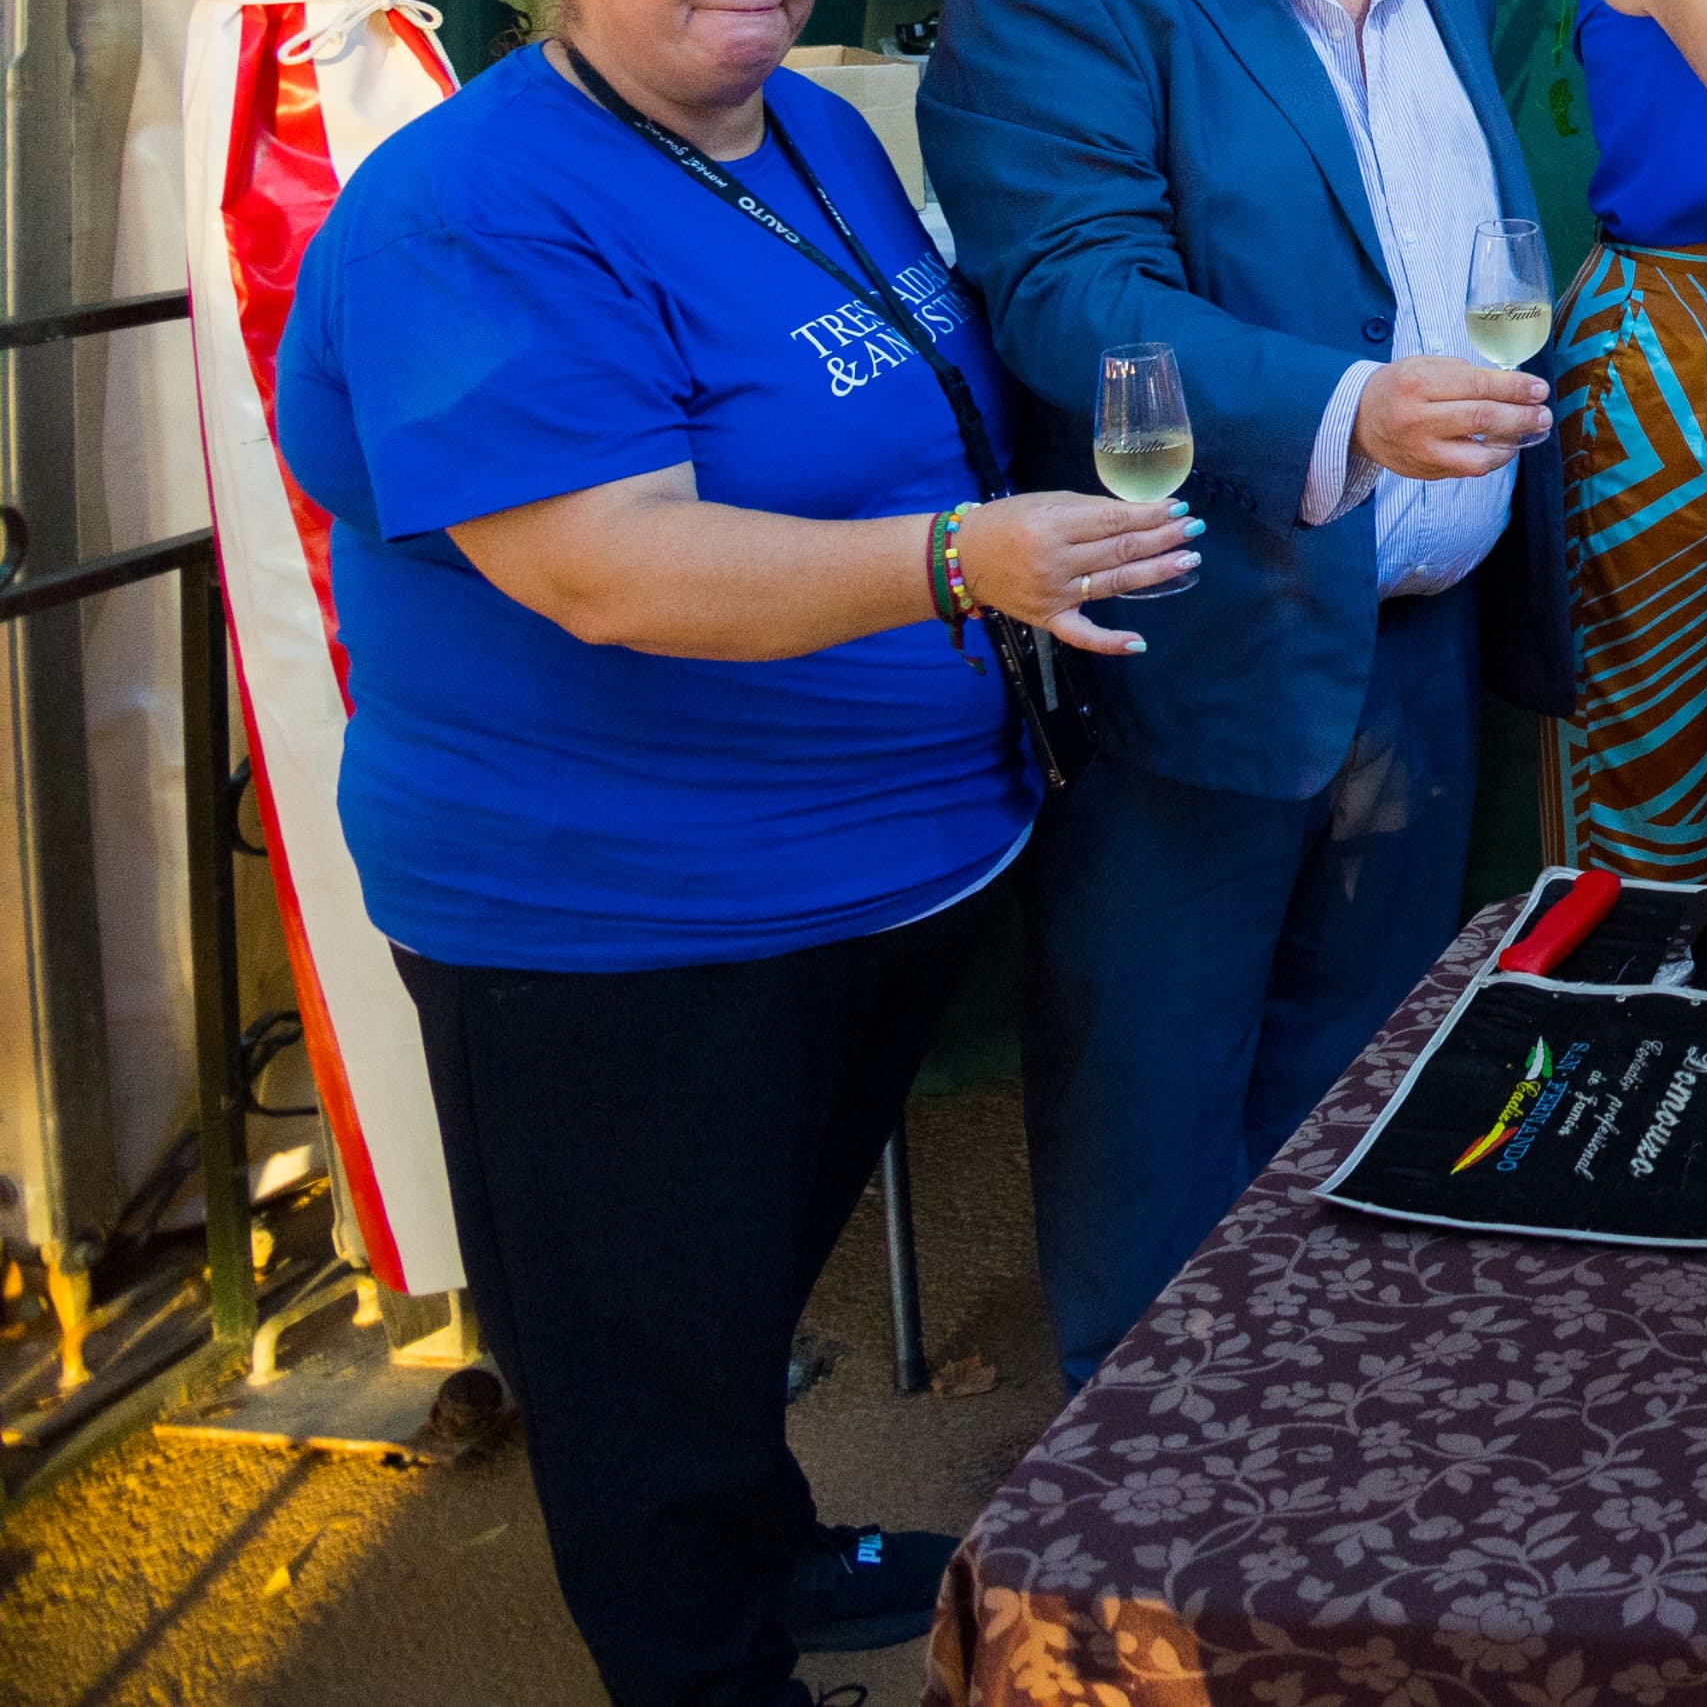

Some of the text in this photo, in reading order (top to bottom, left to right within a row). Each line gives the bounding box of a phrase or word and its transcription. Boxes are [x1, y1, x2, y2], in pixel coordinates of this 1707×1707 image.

[790, 299, 886, 359] TRES
[1478, 303, 1542, 322] La Guita
[826, 356, 869, 398] &
[1587, 1070, 1608, 1087] de
[1496, 1042, 1590, 1172] SAN FERNANDO
[1574, 1040, 1664, 1181] Cortador profesional
